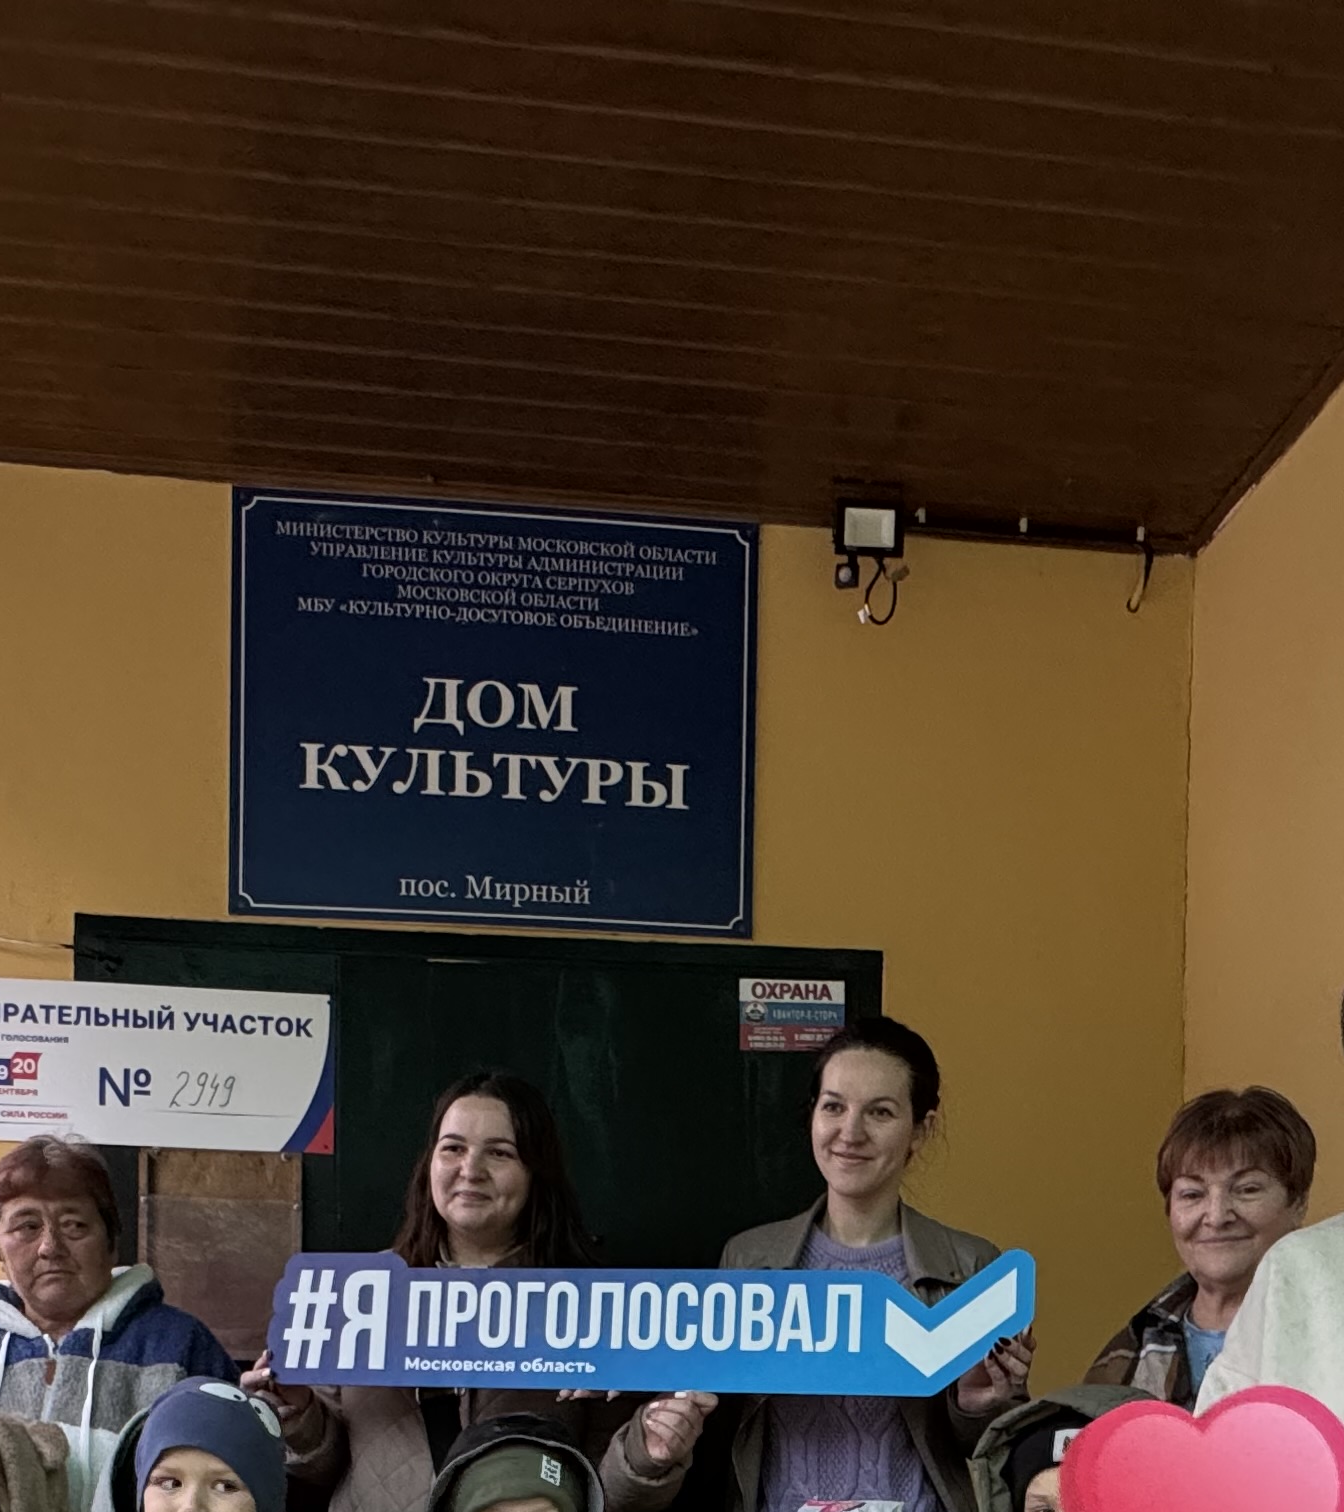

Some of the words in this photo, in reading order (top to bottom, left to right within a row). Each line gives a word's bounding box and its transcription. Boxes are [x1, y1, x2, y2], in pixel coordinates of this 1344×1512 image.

[275, 519, 419, 544] МИНИСТЕРСТВО
[422, 528, 514, 551] КУЛЬТУРЫ
[517, 536, 637, 560] МОСКОВСКОЙ
[639, 545, 718, 566] ОБЛАСТИ
[309, 540, 429, 563] УПРАВЛЕНИЕ
[431, 548, 523, 570] КУЛЬТУРЫ
[527, 555, 685, 581] АДМИНИСТРАЦИИ
[361, 562, 475, 585] ГОРОДСКОГО
[477, 570, 543, 590] ОКРУГА
[545, 575, 636, 596] СЕРПУХОВ
[396, 584, 517, 606] МОСКОВСКОЙ
[520, 592, 600, 612] ОБЛАСТИ
[296, 596, 336, 613] МБУ
[338, 600, 557, 627] «КУЛЬТУРНО-ДОСУГОВОЕ
[559, 613, 699, 637] ОБЪЕДИНЕНИЕ»
[412, 676, 579, 736] ДОМ
[298, 742, 691, 811] КУЛЬТУРЫ
[399, 876, 457, 900] пос.
[464, 873, 592, 908] Мирный
[750, 981, 834, 1002] ОХРАНА
[0, 1034, 69, 1043] ГОЛОСОВАНИЯ
[183, 1011, 314, 1038] УЧАСТОК
[11, 1057, 37, 1075] 20
[98, 1066, 152, 1108] №
[0, 1109, 26, 1120] СИЛА
[281, 1268, 392, 1371] #Я
[405, 1279, 865, 1354] ПРОГОЛОСОВАЛ
[403, 1355, 516, 1374] Московская
[519, 1357, 597, 1375] область
